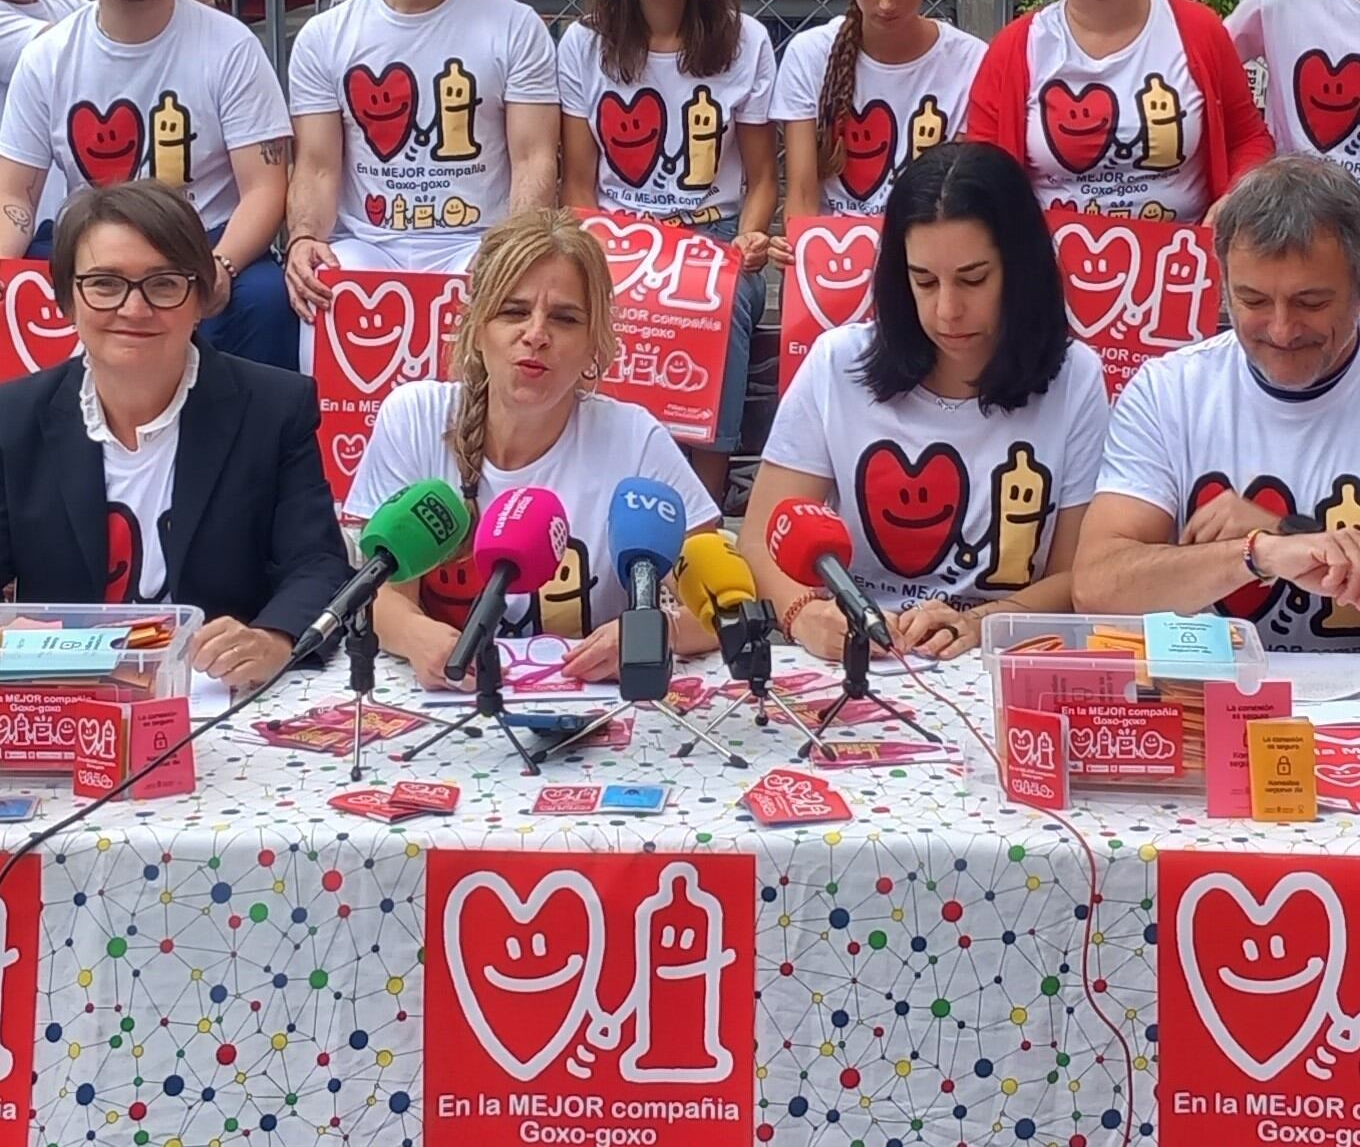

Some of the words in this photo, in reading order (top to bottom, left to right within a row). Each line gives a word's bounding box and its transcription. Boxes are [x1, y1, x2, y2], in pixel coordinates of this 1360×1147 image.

[357, 163, 368, 174] En
[381, 167, 425, 178] MEJOR
[1076, 171, 1124, 184] MEJOR
[386, 179, 450, 191] Goxo-goxo
[1080, 183, 1148, 196] Goxo-goxo
[634, 191, 676, 205] MEJOR
[789, 341, 807, 354] En
[320, 398, 339, 412] En
[342, 399, 355, 412] la
[623, 490, 677, 523] tve
[793, 503, 841, 520] rne
[769, 513, 792, 559] rne
[5, 694, 42, 704] MEJOR
[1088, 706, 1126, 716] MEJOR
[438, 1094, 470, 1117] En
[478, 1094, 501, 1116] la
[509, 1094, 604, 1118] MEJOR
[1173, 1092, 1206, 1114] En
[1215, 1092, 1238, 1114] la
[1246, 1094, 1345, 1119] MEJOR
[520, 1120, 657, 1147] Goxo-goxo
